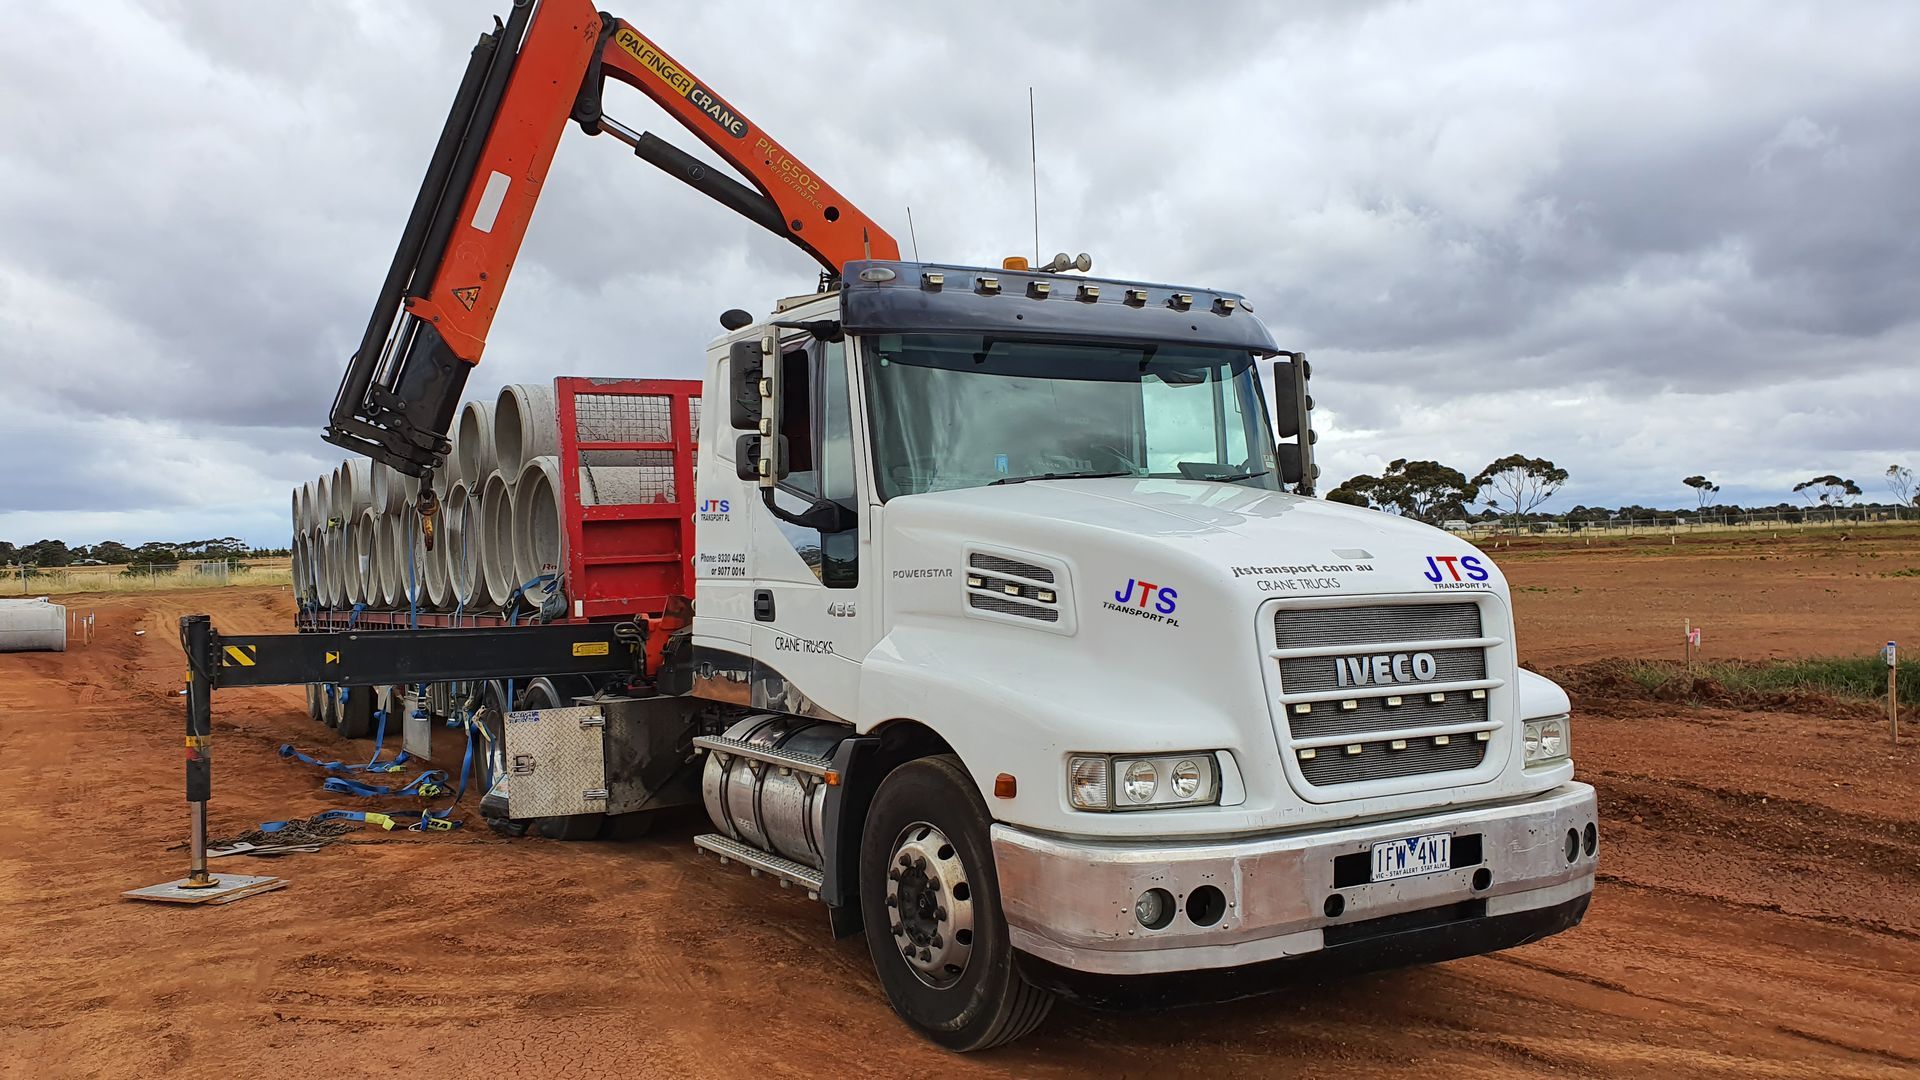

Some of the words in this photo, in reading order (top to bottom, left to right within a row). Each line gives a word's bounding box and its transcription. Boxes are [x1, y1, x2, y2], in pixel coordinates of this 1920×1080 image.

[619, 32, 691, 93] PALFINGER
[690, 88, 743, 135] CRANE
[755, 137, 778, 159] PK
[776, 155, 820, 195] 16502
[700, 499, 730, 513] JTS
[701, 513, 724, 521] TRANSPORT
[724, 513, 730, 521] PL
[701, 553, 716, 563] Phone:
[717, 553, 731, 563] 9330
[731, 553, 745, 563] 4439
[711, 568, 717, 576] or
[717, 566, 731, 576] 9077
[731, 566, 745, 577] 0014
[892, 568, 953, 579] POWERSTAR
[1424, 555, 1489, 583] JTS
[1257, 580, 1297, 591] CRANE
[1298, 578, 1341, 590] TRUCKS
[1115, 578, 1178, 614] JTS
[827, 601, 856, 618] 435
[1102, 601, 1165, 623] TRANSPORT
[1166, 617, 1180, 628] PL
[775, 636, 800, 652] CRANE
[803, 639, 834, 655] TRUCKS
[1335, 652, 1437, 687] IVECO
